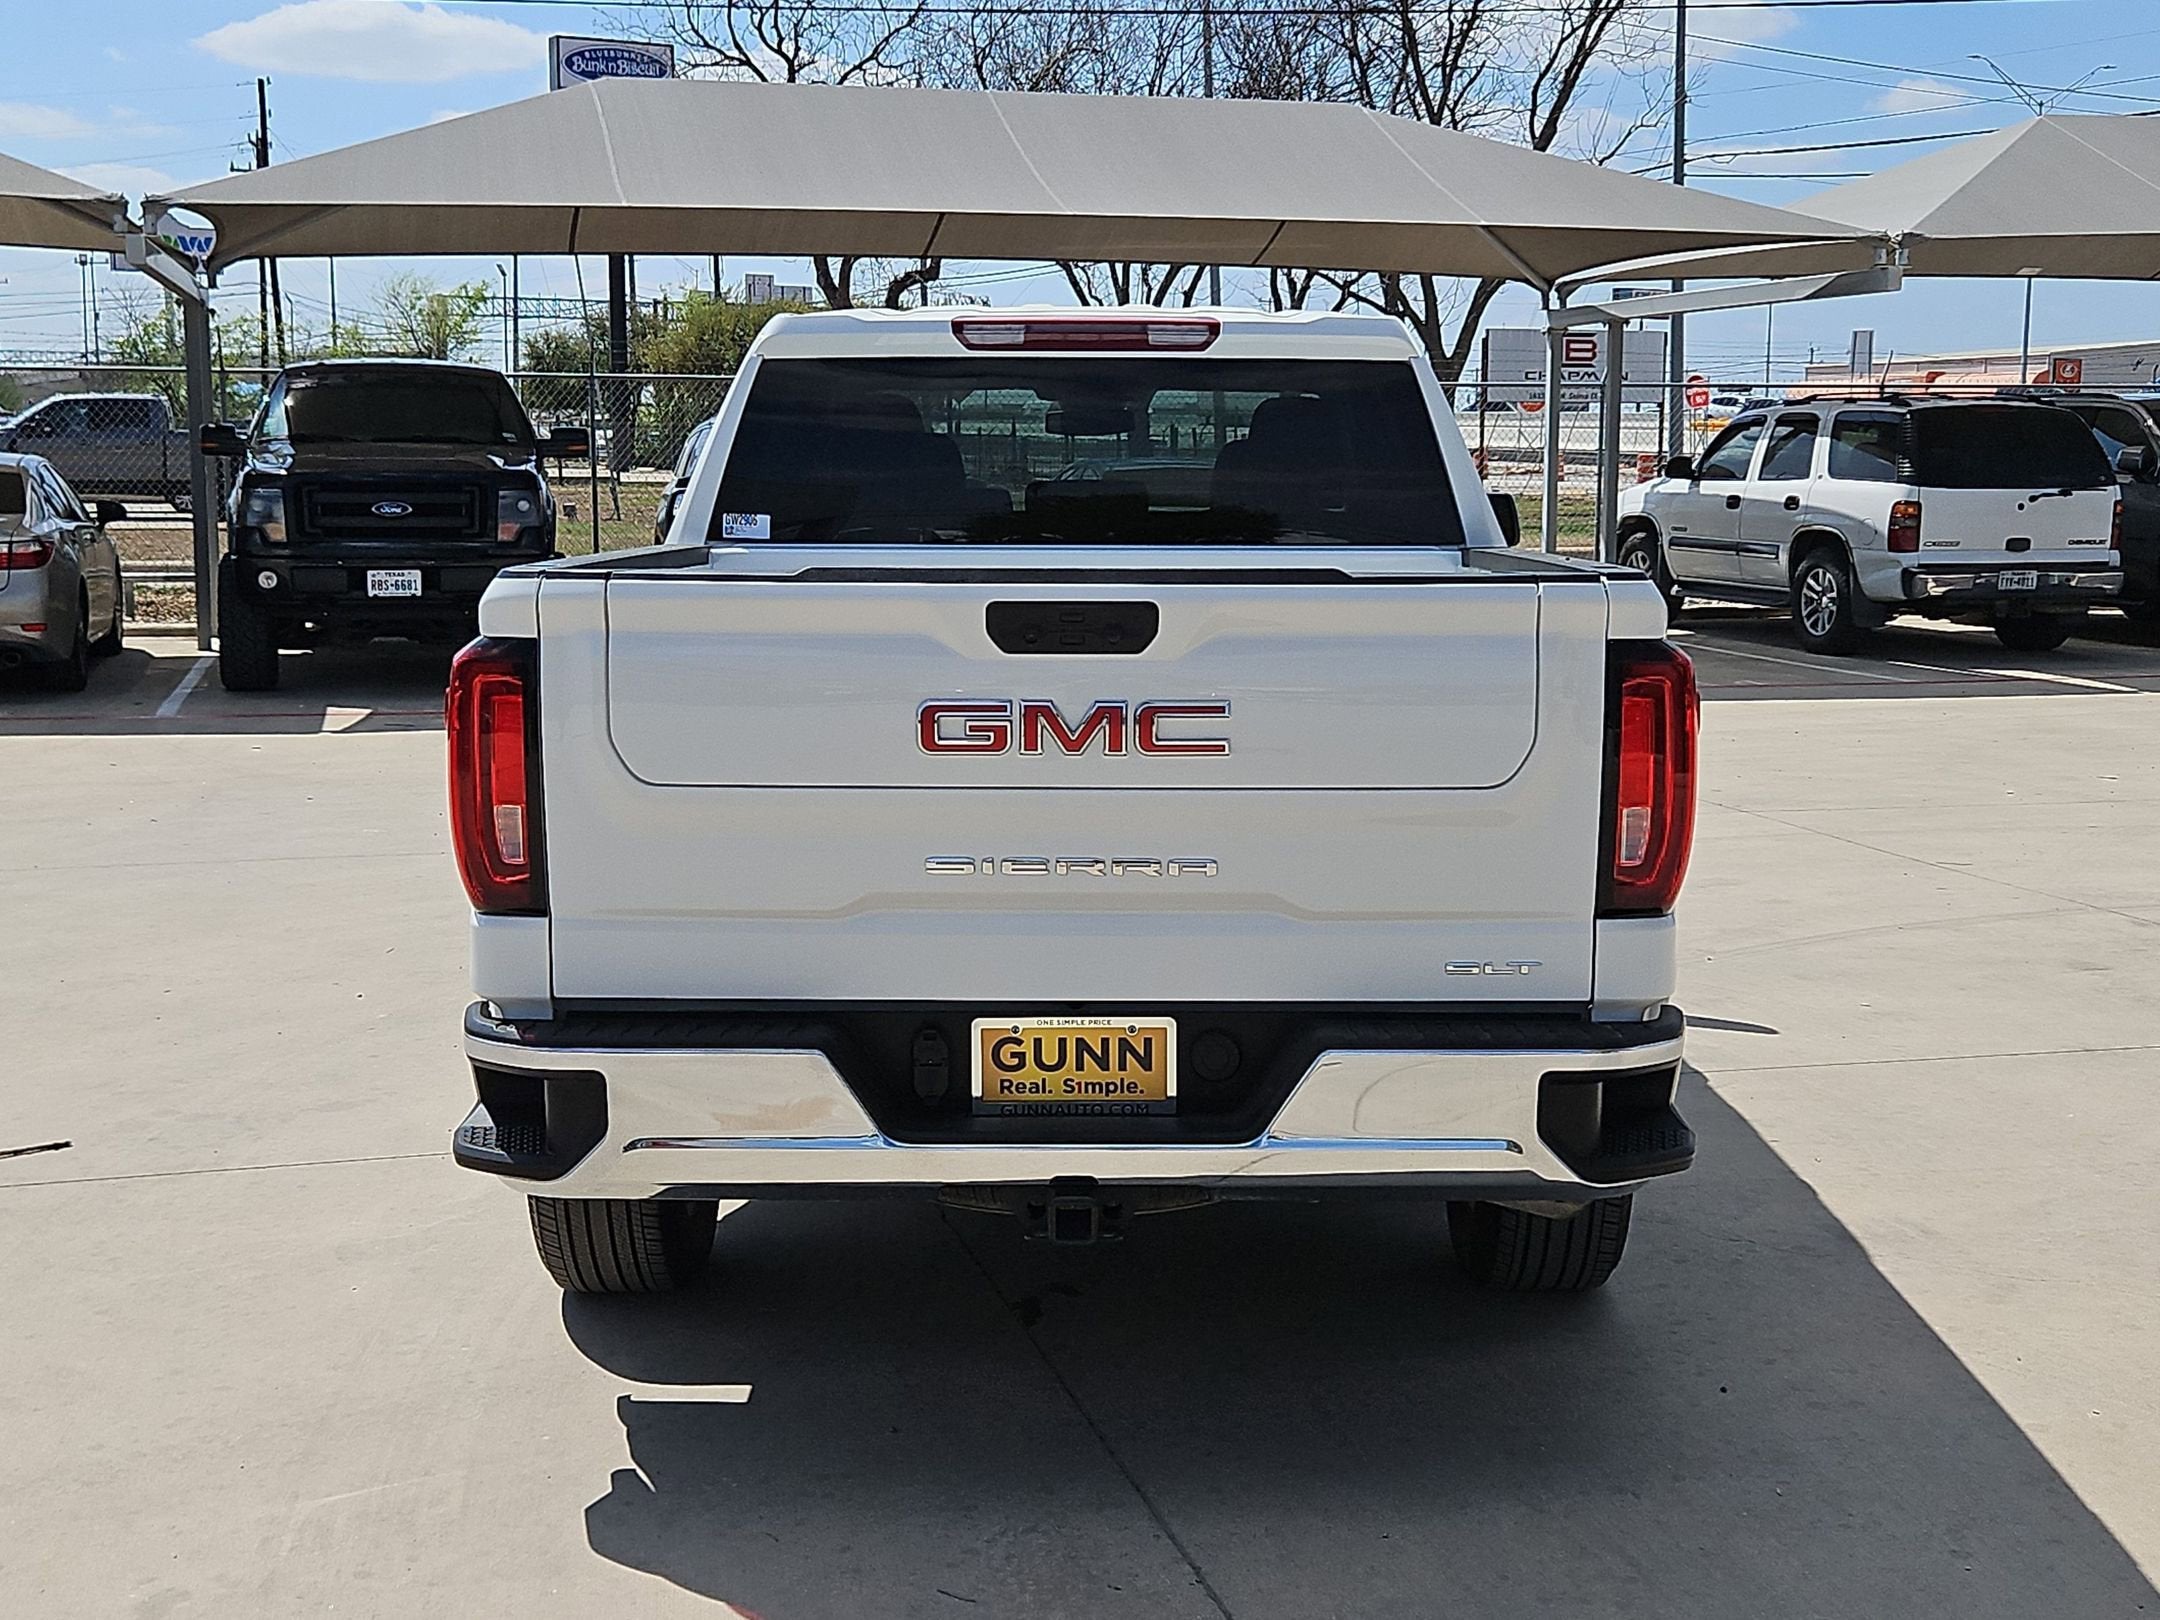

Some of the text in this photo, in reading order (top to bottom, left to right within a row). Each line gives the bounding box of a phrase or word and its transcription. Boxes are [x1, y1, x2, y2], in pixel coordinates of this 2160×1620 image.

[1524, 371, 1629, 381] CHPMN
[916, 699, 1231, 757] GMC
[924, 856, 1219, 877] SIERRA
[1445, 961, 1543, 975] SLT
[991, 1036, 1153, 1073] GUNN
[1000, 1078, 1053, 1094] Real.
[1001, 1104, 1150, 1116] GUNNAUTO.COM
